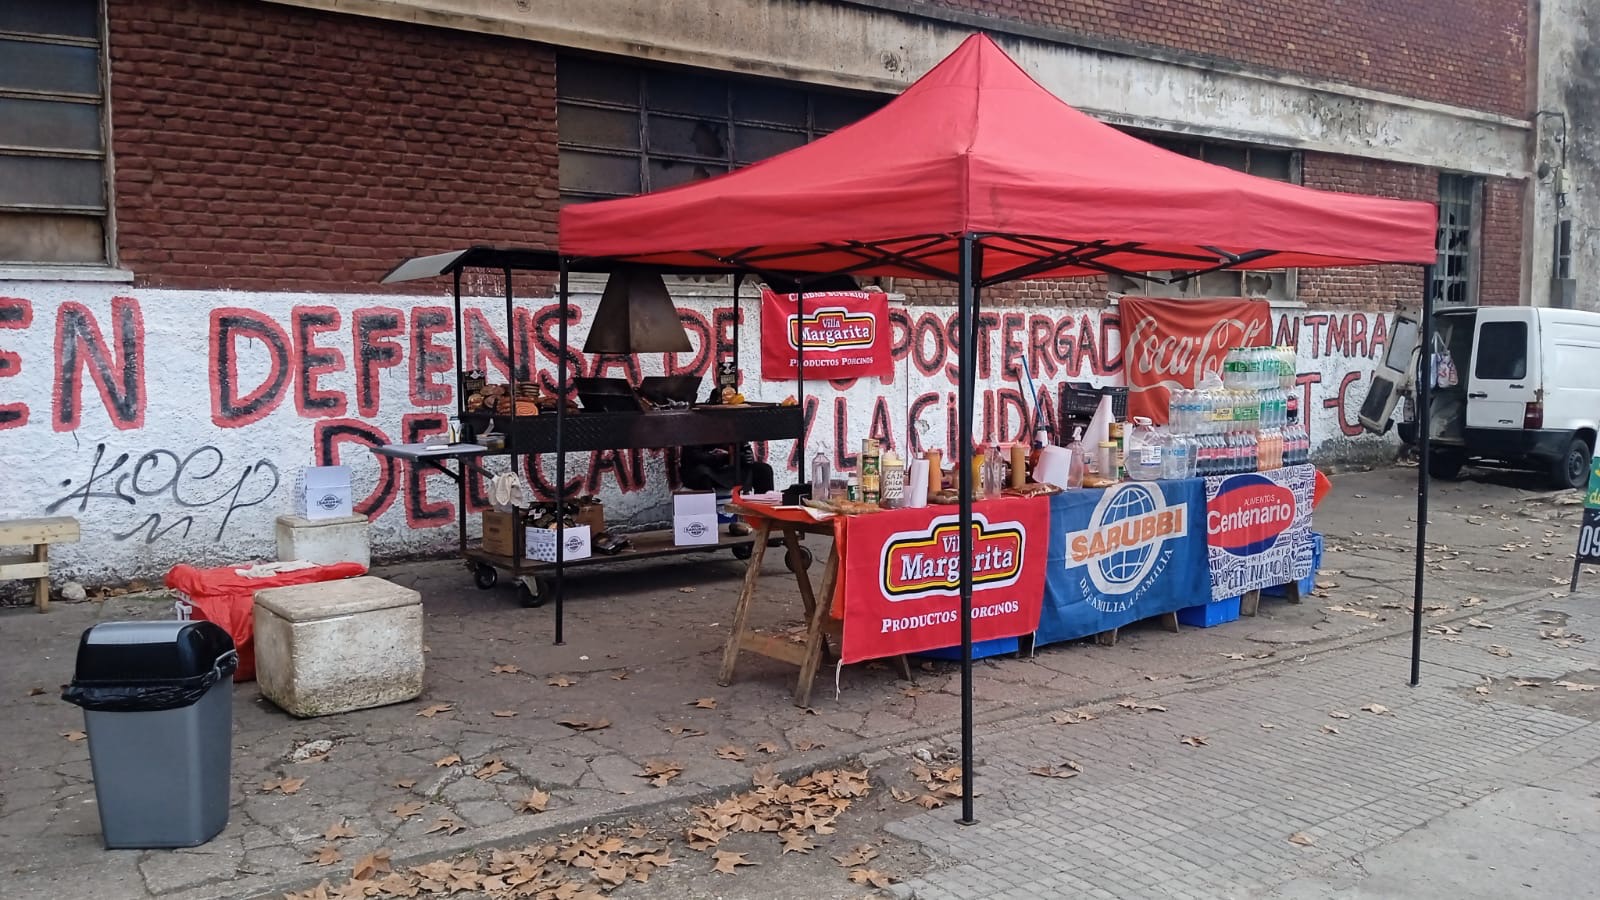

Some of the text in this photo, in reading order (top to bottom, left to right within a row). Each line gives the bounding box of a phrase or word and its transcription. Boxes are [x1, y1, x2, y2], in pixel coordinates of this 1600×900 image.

[802, 325, 870, 344] Margarita
[822, 318, 841, 328] Villa
[664, 307, 744, 388] DE
[789, 358, 839, 367] PODUCTOS
[1125, 316, 1268, 393] Coca-Col
[834, 396, 896, 473] LA
[1071, 508, 1183, 562] SARUBBI
[1207, 499, 1291, 535] Centenario
[900, 546, 1013, 582] Margrita
[1086, 594, 1127, 612] FAMILIA
[1135, 549, 1174, 600] FAMILIA
[881, 600, 1019, 633] PRODUCTOS ORCINOS
